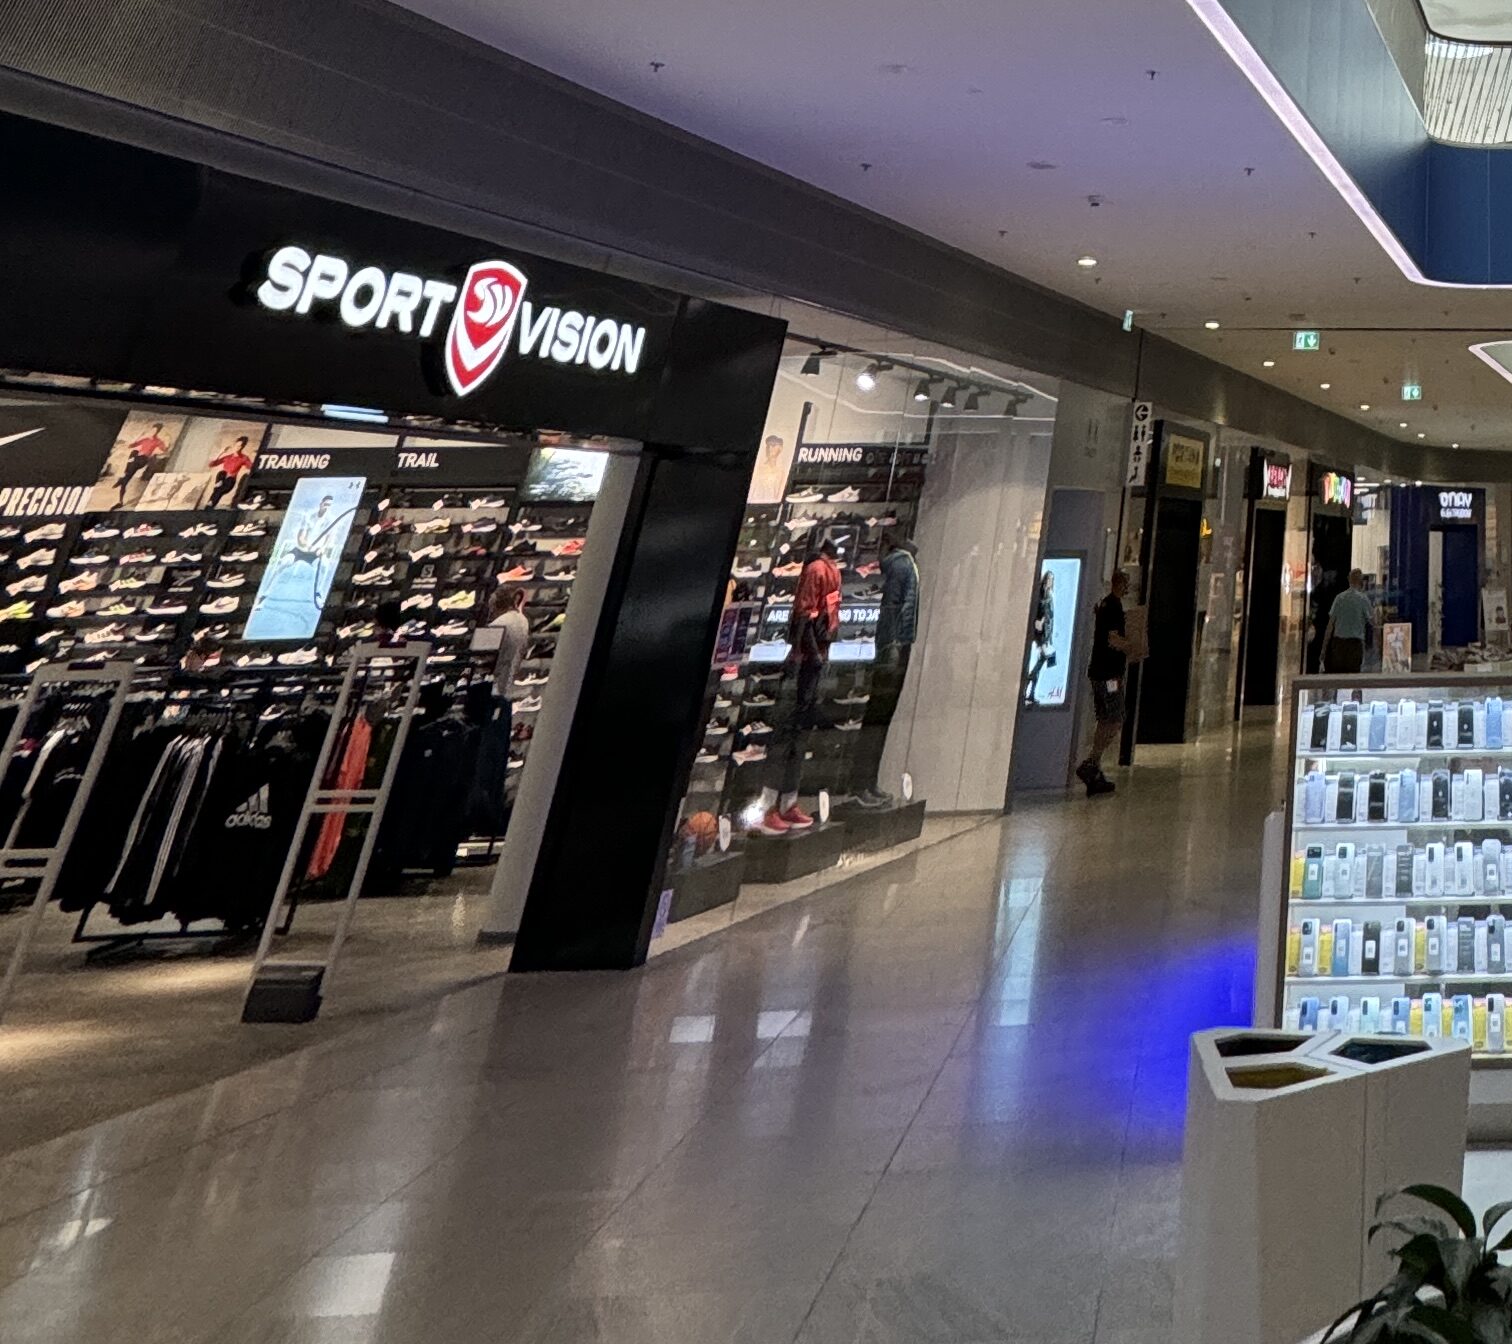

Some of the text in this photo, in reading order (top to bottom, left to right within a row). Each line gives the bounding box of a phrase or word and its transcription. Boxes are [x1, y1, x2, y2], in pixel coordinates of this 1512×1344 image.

[257, 246, 457, 338] SPORT
[518, 301, 646, 374] VISION
[258, 453, 330, 470] TRAINING
[397, 453, 439, 468] TRAIL
[797, 447, 863, 464] RUNNING
[224, 810, 272, 830] adidas
